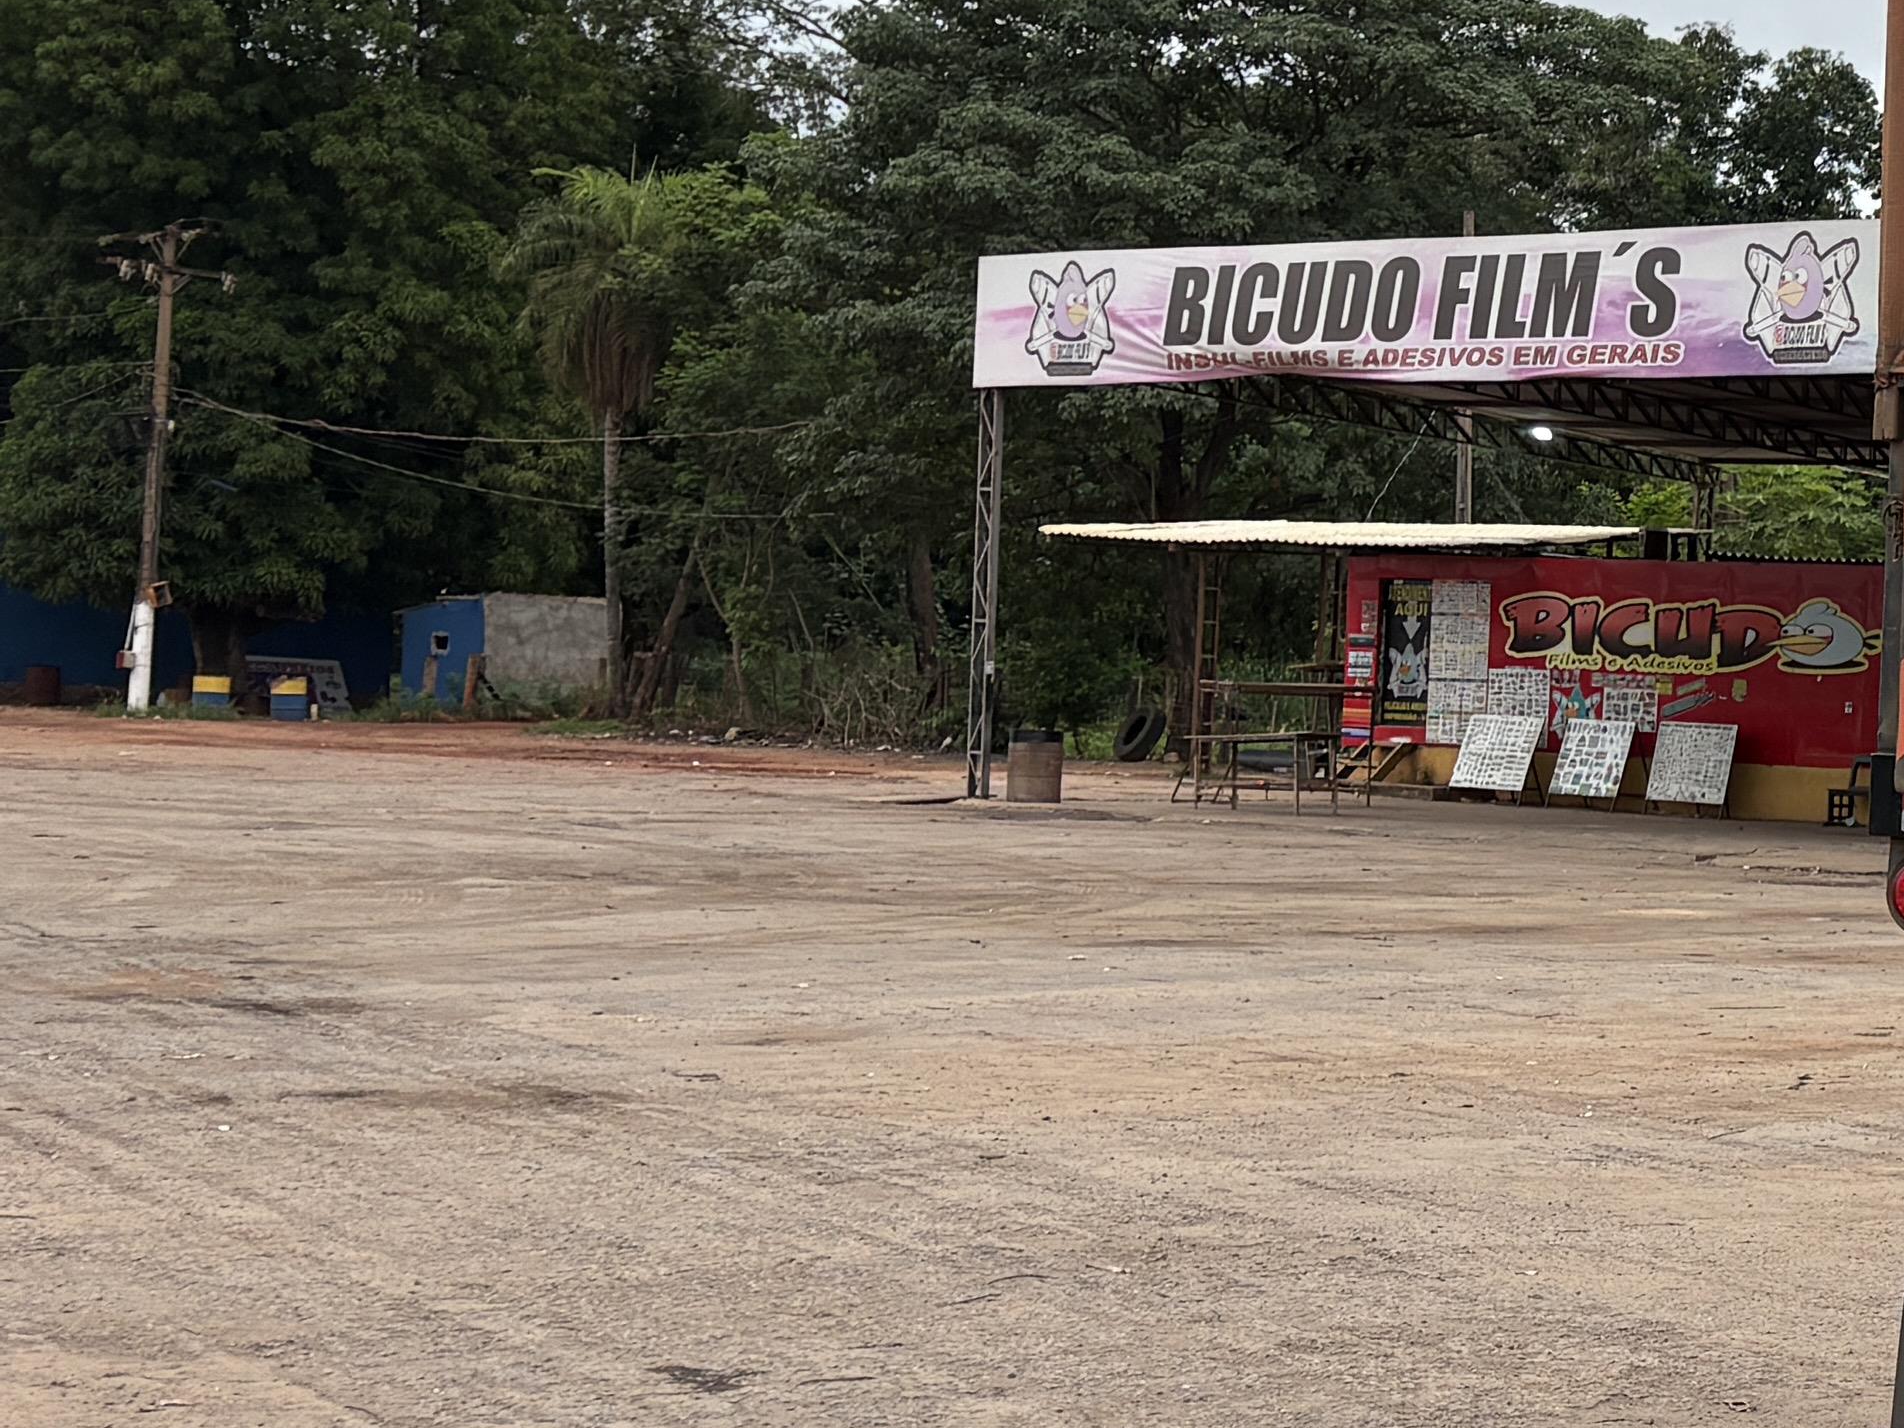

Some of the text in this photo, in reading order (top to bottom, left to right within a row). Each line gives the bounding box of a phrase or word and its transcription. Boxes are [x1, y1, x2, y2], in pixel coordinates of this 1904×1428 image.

[1163, 256, 1421, 346] BICUDO
[1337, 349, 1355, 367] E
[1362, 346, 1504, 368] ADESIVOS
[1513, 346, 1557, 366] EM
[1566, 343, 1682, 365] GERAIS
[1548, 653, 1599, 667] Films
[1627, 655, 1714, 672] Adesivos
